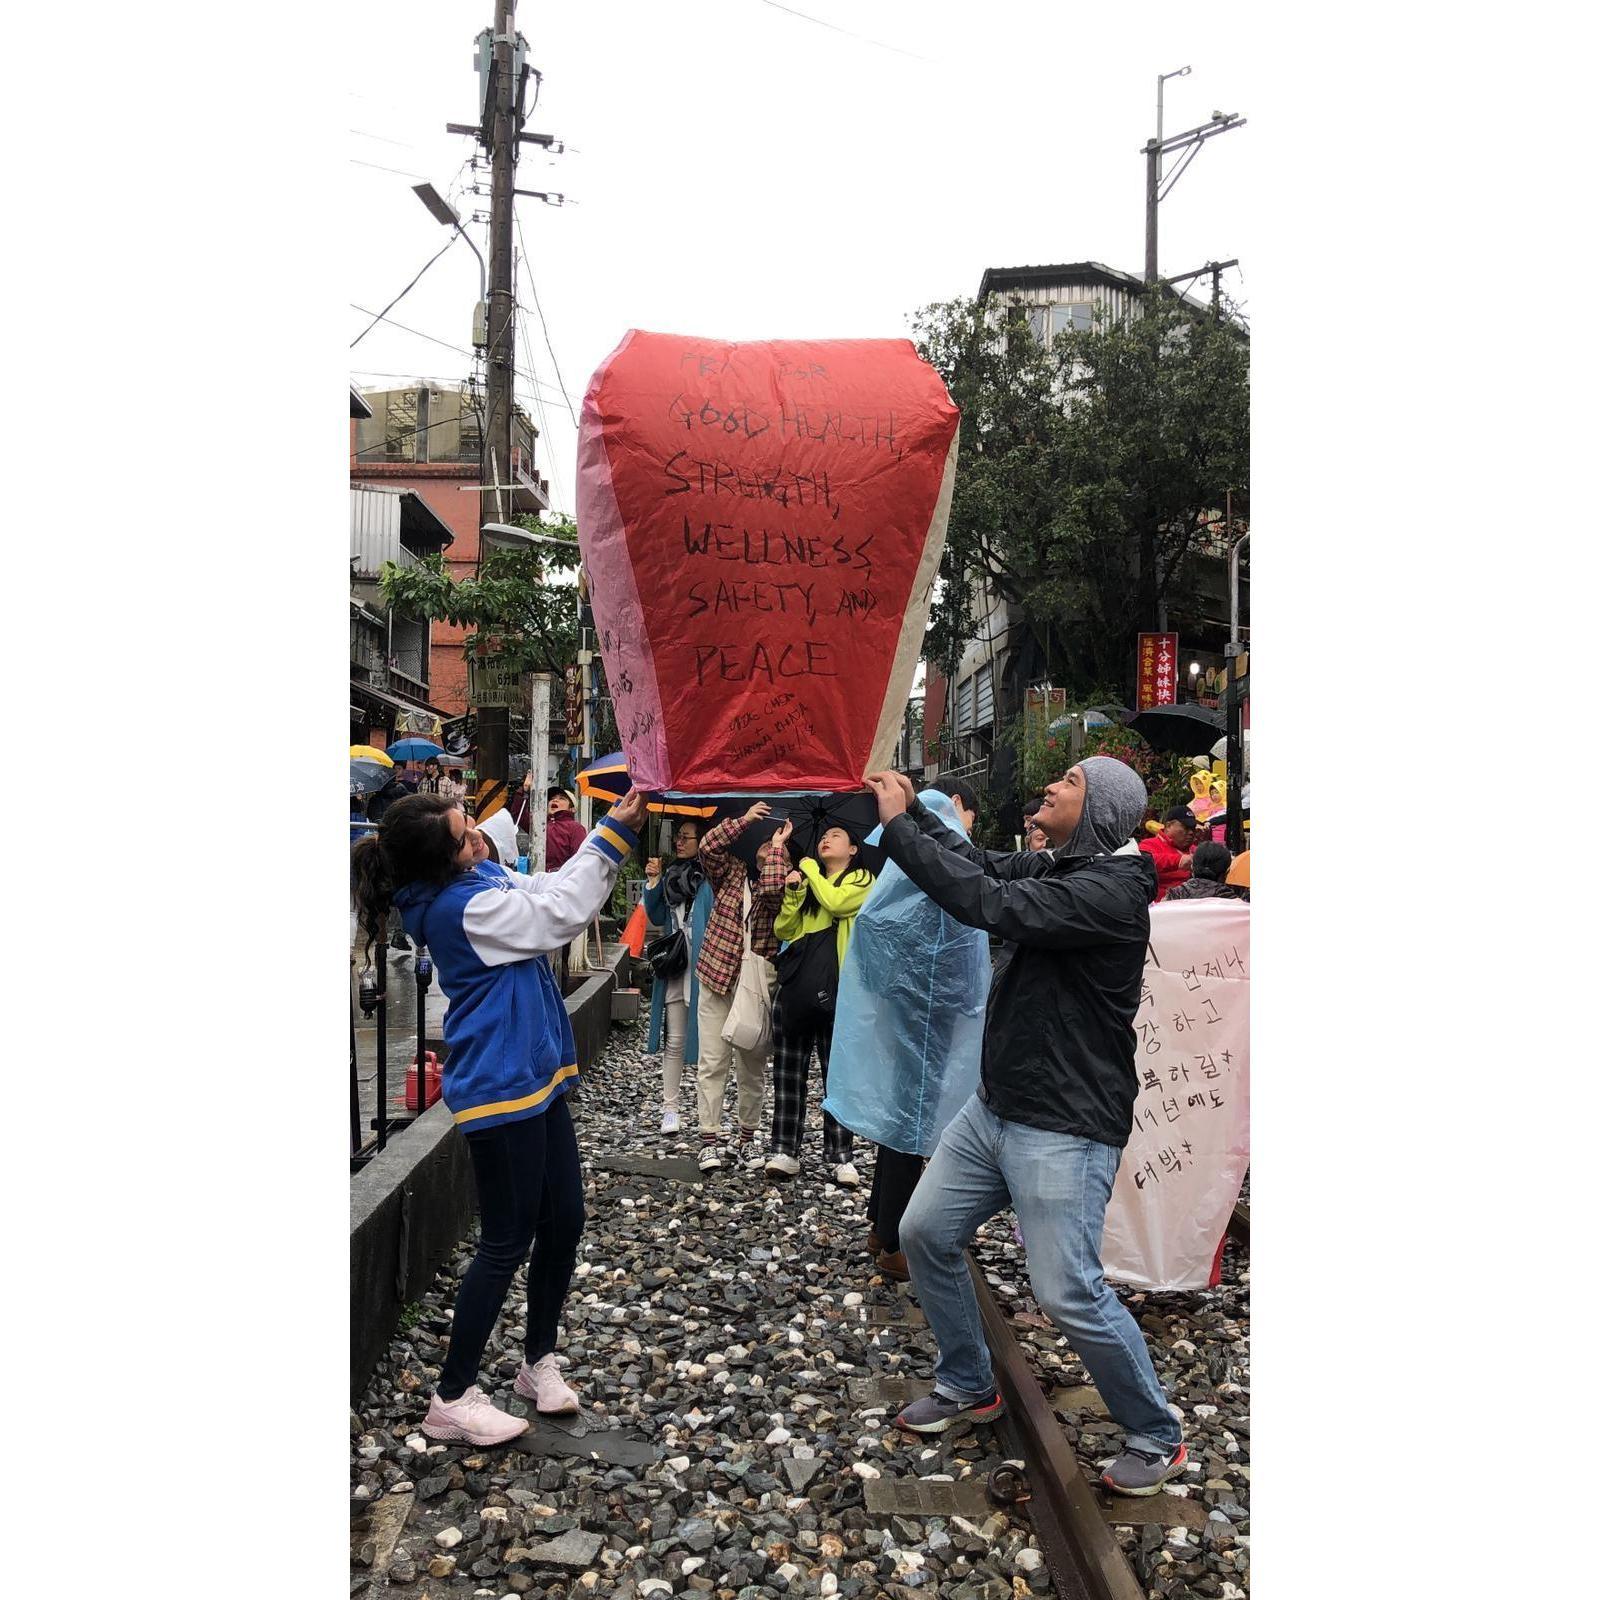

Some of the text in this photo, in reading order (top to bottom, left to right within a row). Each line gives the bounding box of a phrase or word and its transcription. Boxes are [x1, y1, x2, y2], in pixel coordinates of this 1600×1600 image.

[668, 392, 771, 440] GOOD
[835, 588, 879, 622] AND
[692, 640, 838, 687] PEACE
[1182, 945, 1245, 992] 언제나
[1136, 998, 1223, 1055] 강하고
